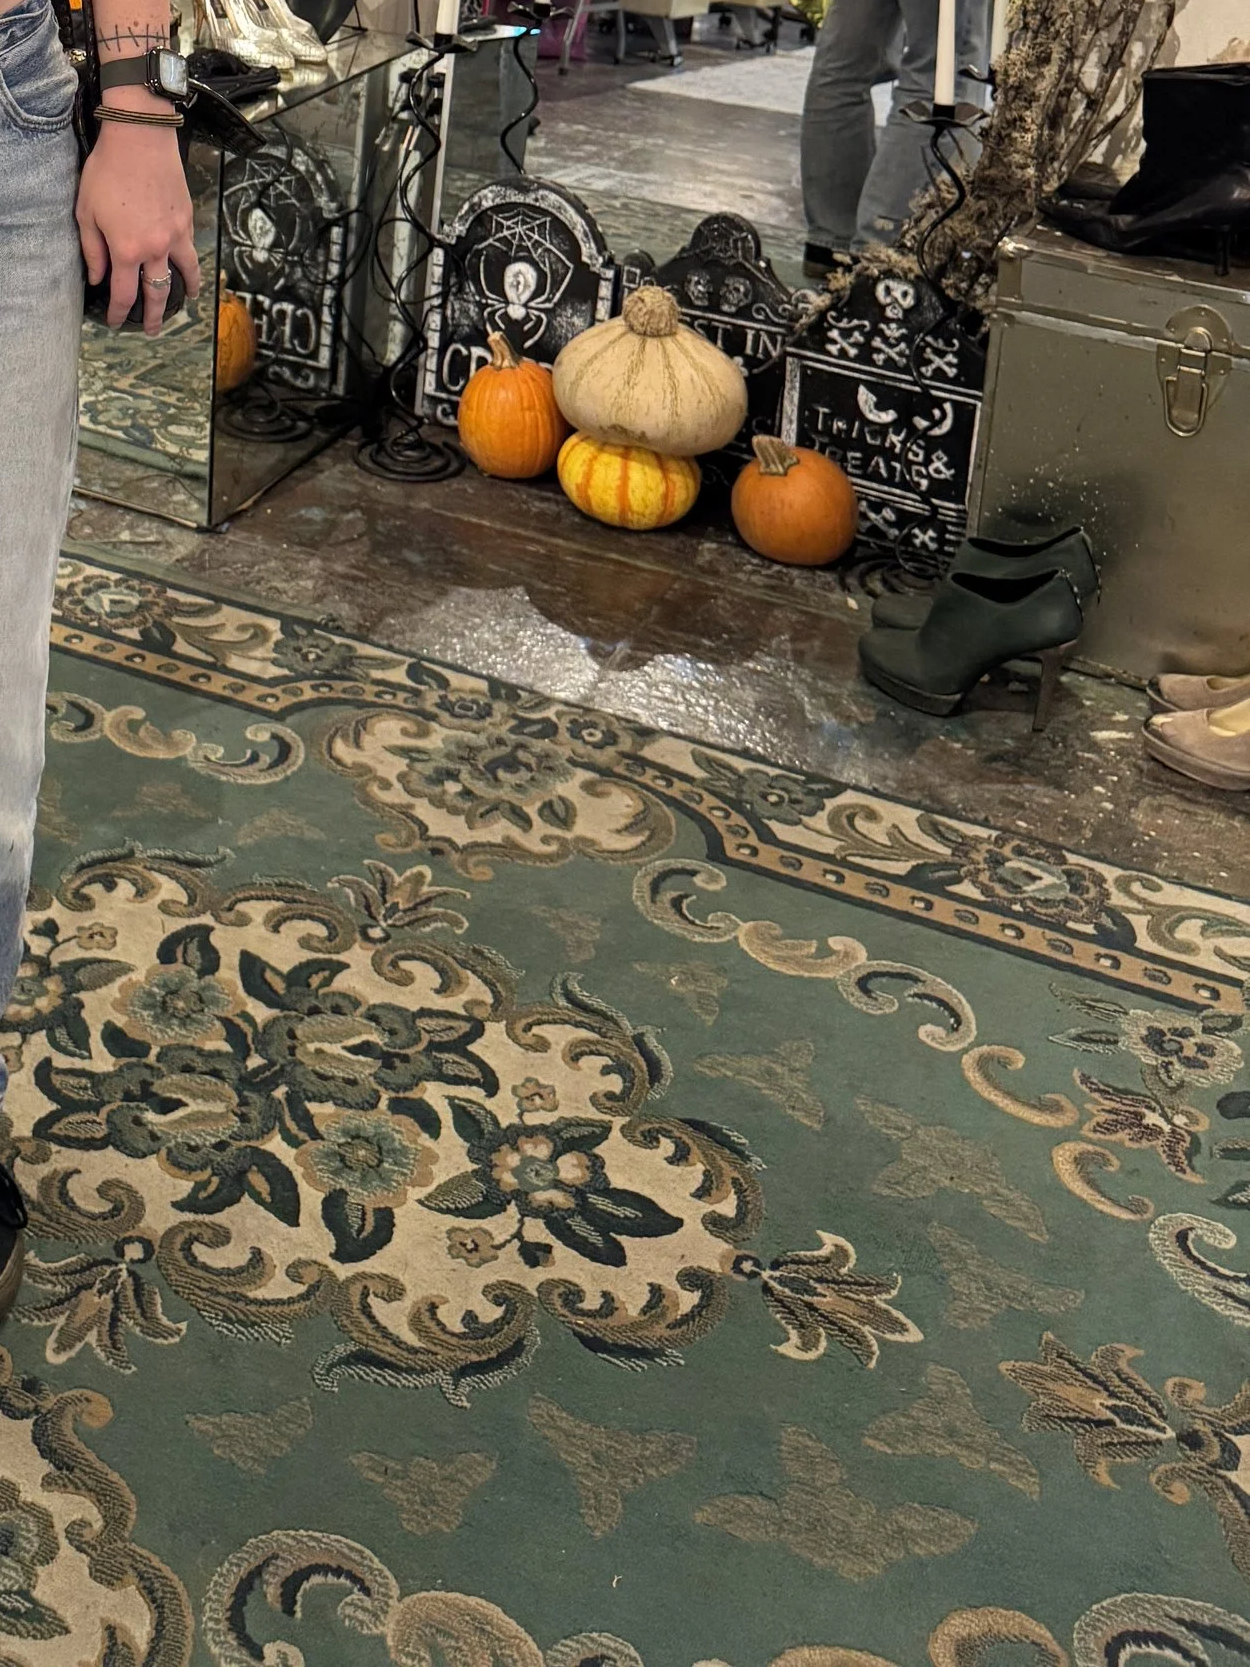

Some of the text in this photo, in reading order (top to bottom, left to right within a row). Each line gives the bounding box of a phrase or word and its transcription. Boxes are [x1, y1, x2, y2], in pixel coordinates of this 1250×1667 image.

[744, 329, 785, 358] IN
[812, 401, 956, 481] TRICKS &
